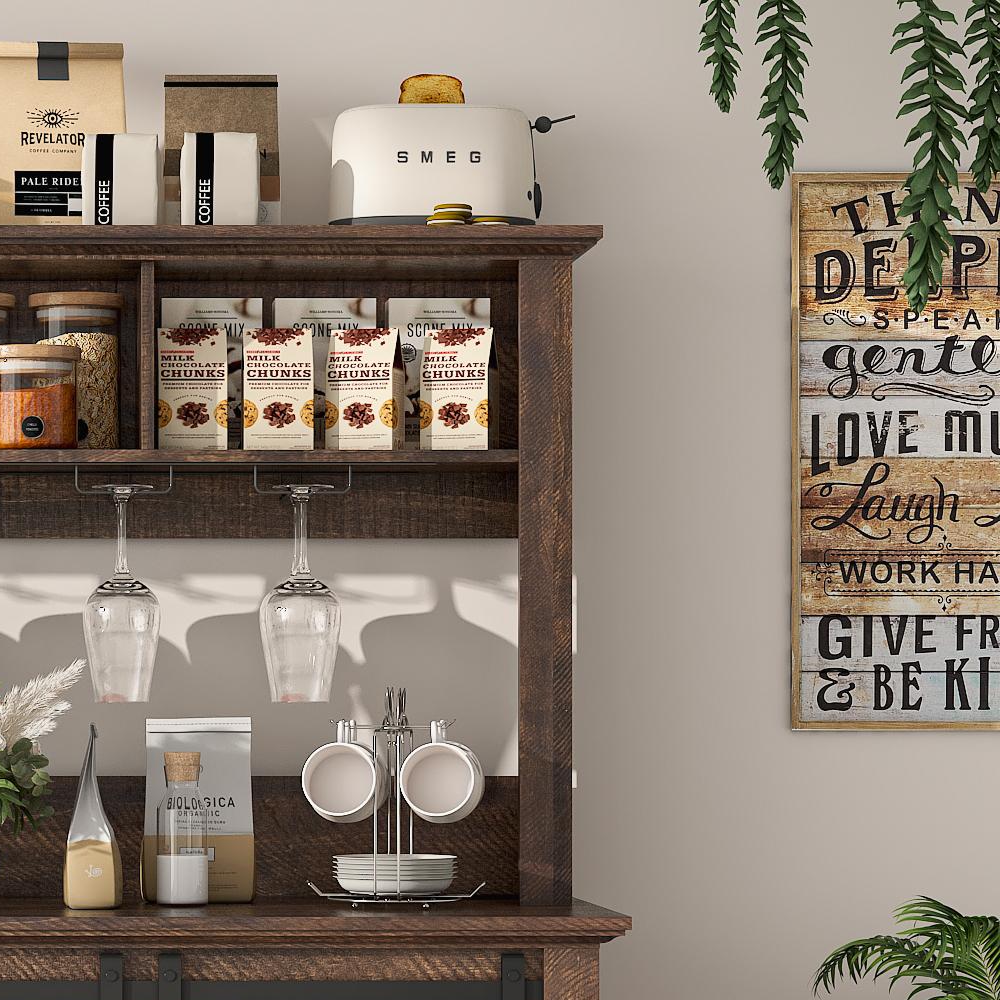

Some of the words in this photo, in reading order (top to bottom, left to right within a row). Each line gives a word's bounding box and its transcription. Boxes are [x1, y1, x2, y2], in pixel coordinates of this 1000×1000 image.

[20, 131, 86, 148] REVELATOR
[396, 150, 482, 164] SMEG
[20, 177, 49, 186] PALE
[51, 177, 82, 186] RIDE
[98, 179, 111, 225] COFFEE
[198, 178, 211, 224] COFFEE
[328, 355, 363, 363] MILK
[423, 355, 458, 363] MILK
[327, 362, 391, 370] CHOCOLATE
[422, 362, 486, 370] CHOCOLATE
[160, 369, 225, 378] CHUNKS
[246, 369, 312, 378] CHUNKS
[327, 369, 390, 379] CHUNKS
[422, 369, 486, 379] CHUNKS
[811, 409, 920, 477] LOVE
[804, 461, 961, 545] Laugh
[838, 560, 942, 584] WORK
[817, 613, 937, 661] GIVE
[816, 667, 856, 712] &
[872, 660, 923, 711] BE
[943, 656, 991, 711] KI
